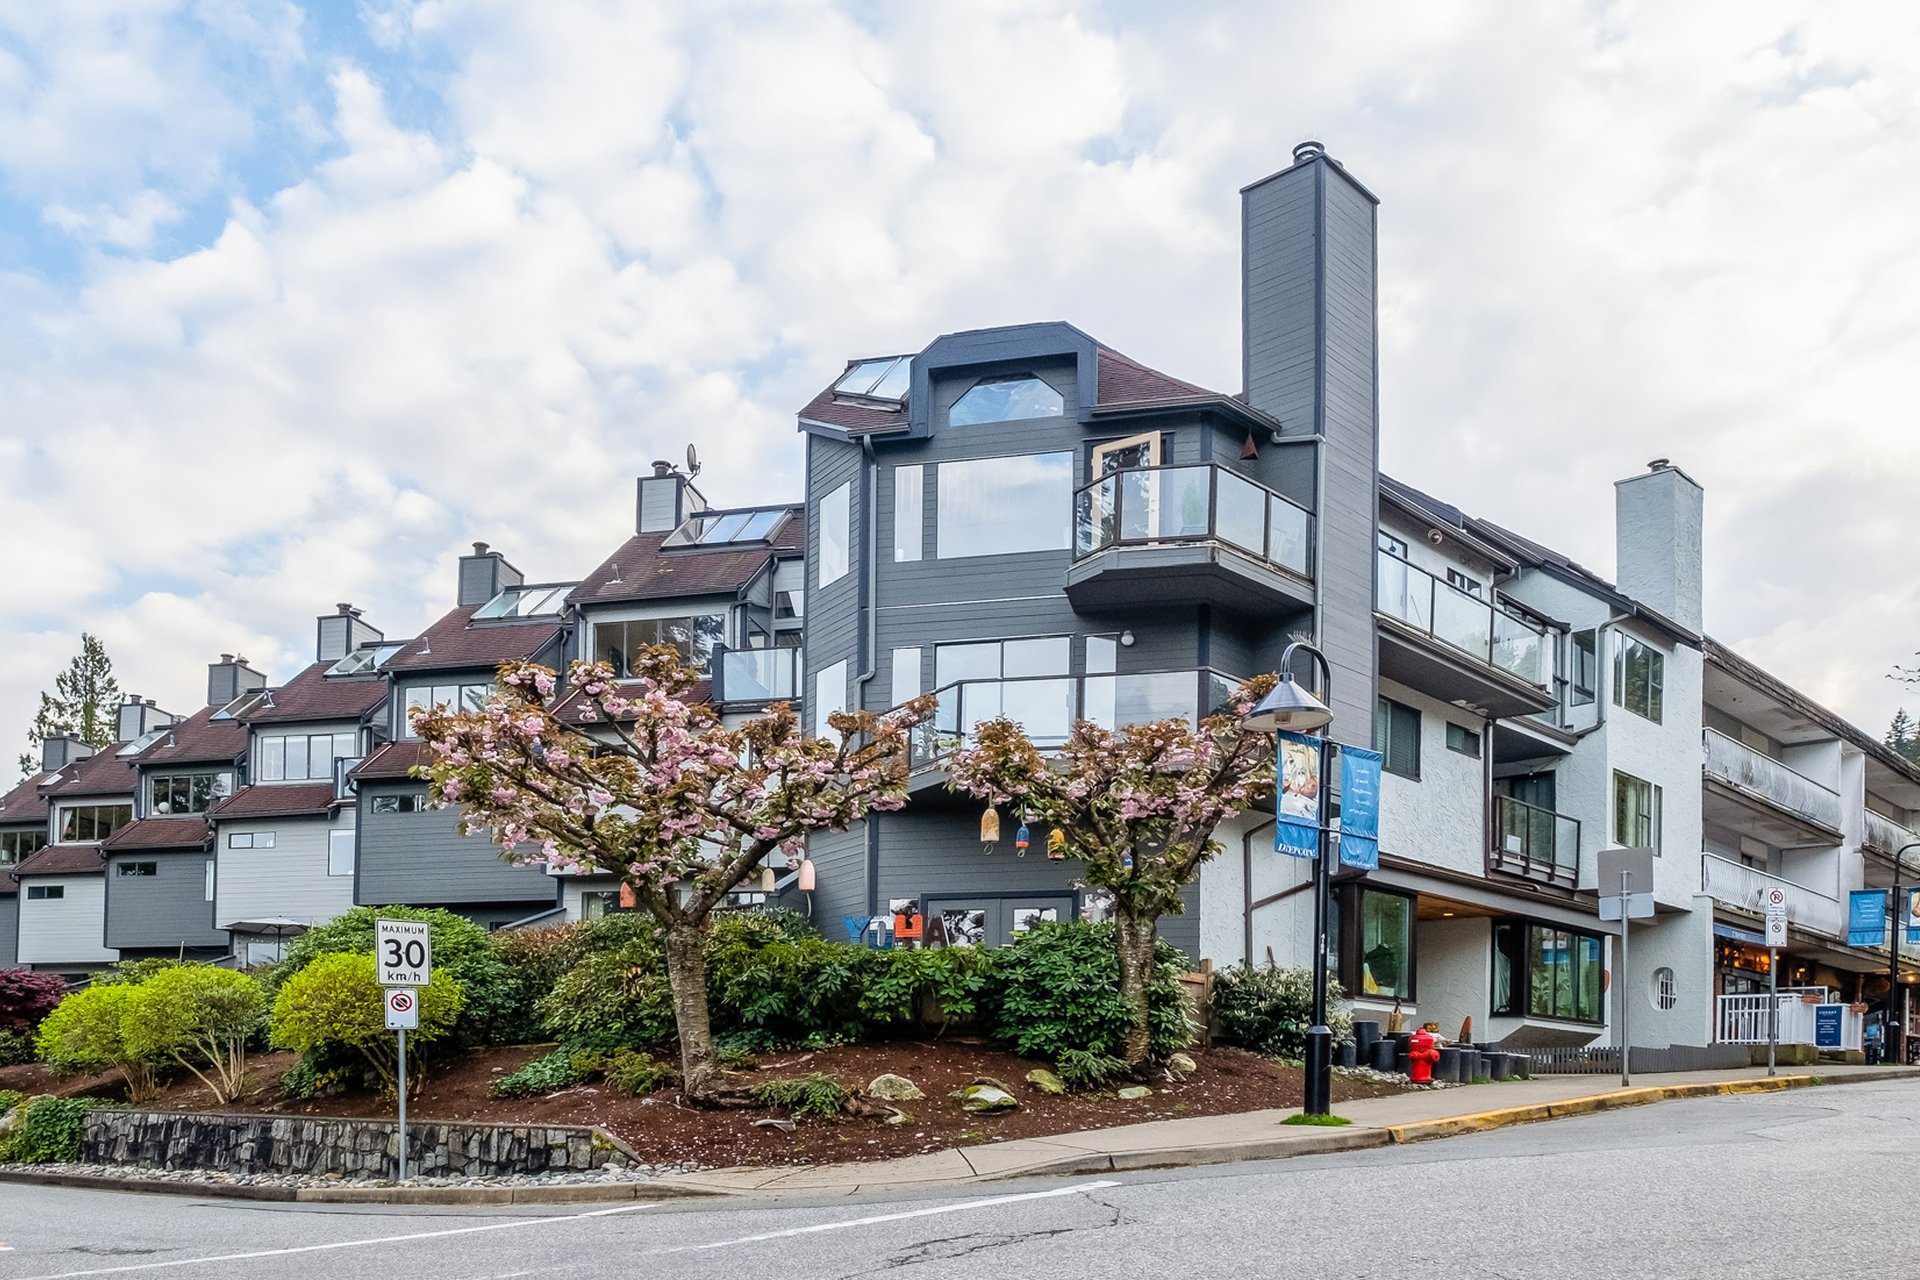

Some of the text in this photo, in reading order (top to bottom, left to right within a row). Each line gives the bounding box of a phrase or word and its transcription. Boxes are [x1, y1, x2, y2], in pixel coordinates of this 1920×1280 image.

[382, 925, 425, 935] MAXIMUM
[384, 938, 425, 969] 30
[387, 971, 421, 982] km/h
